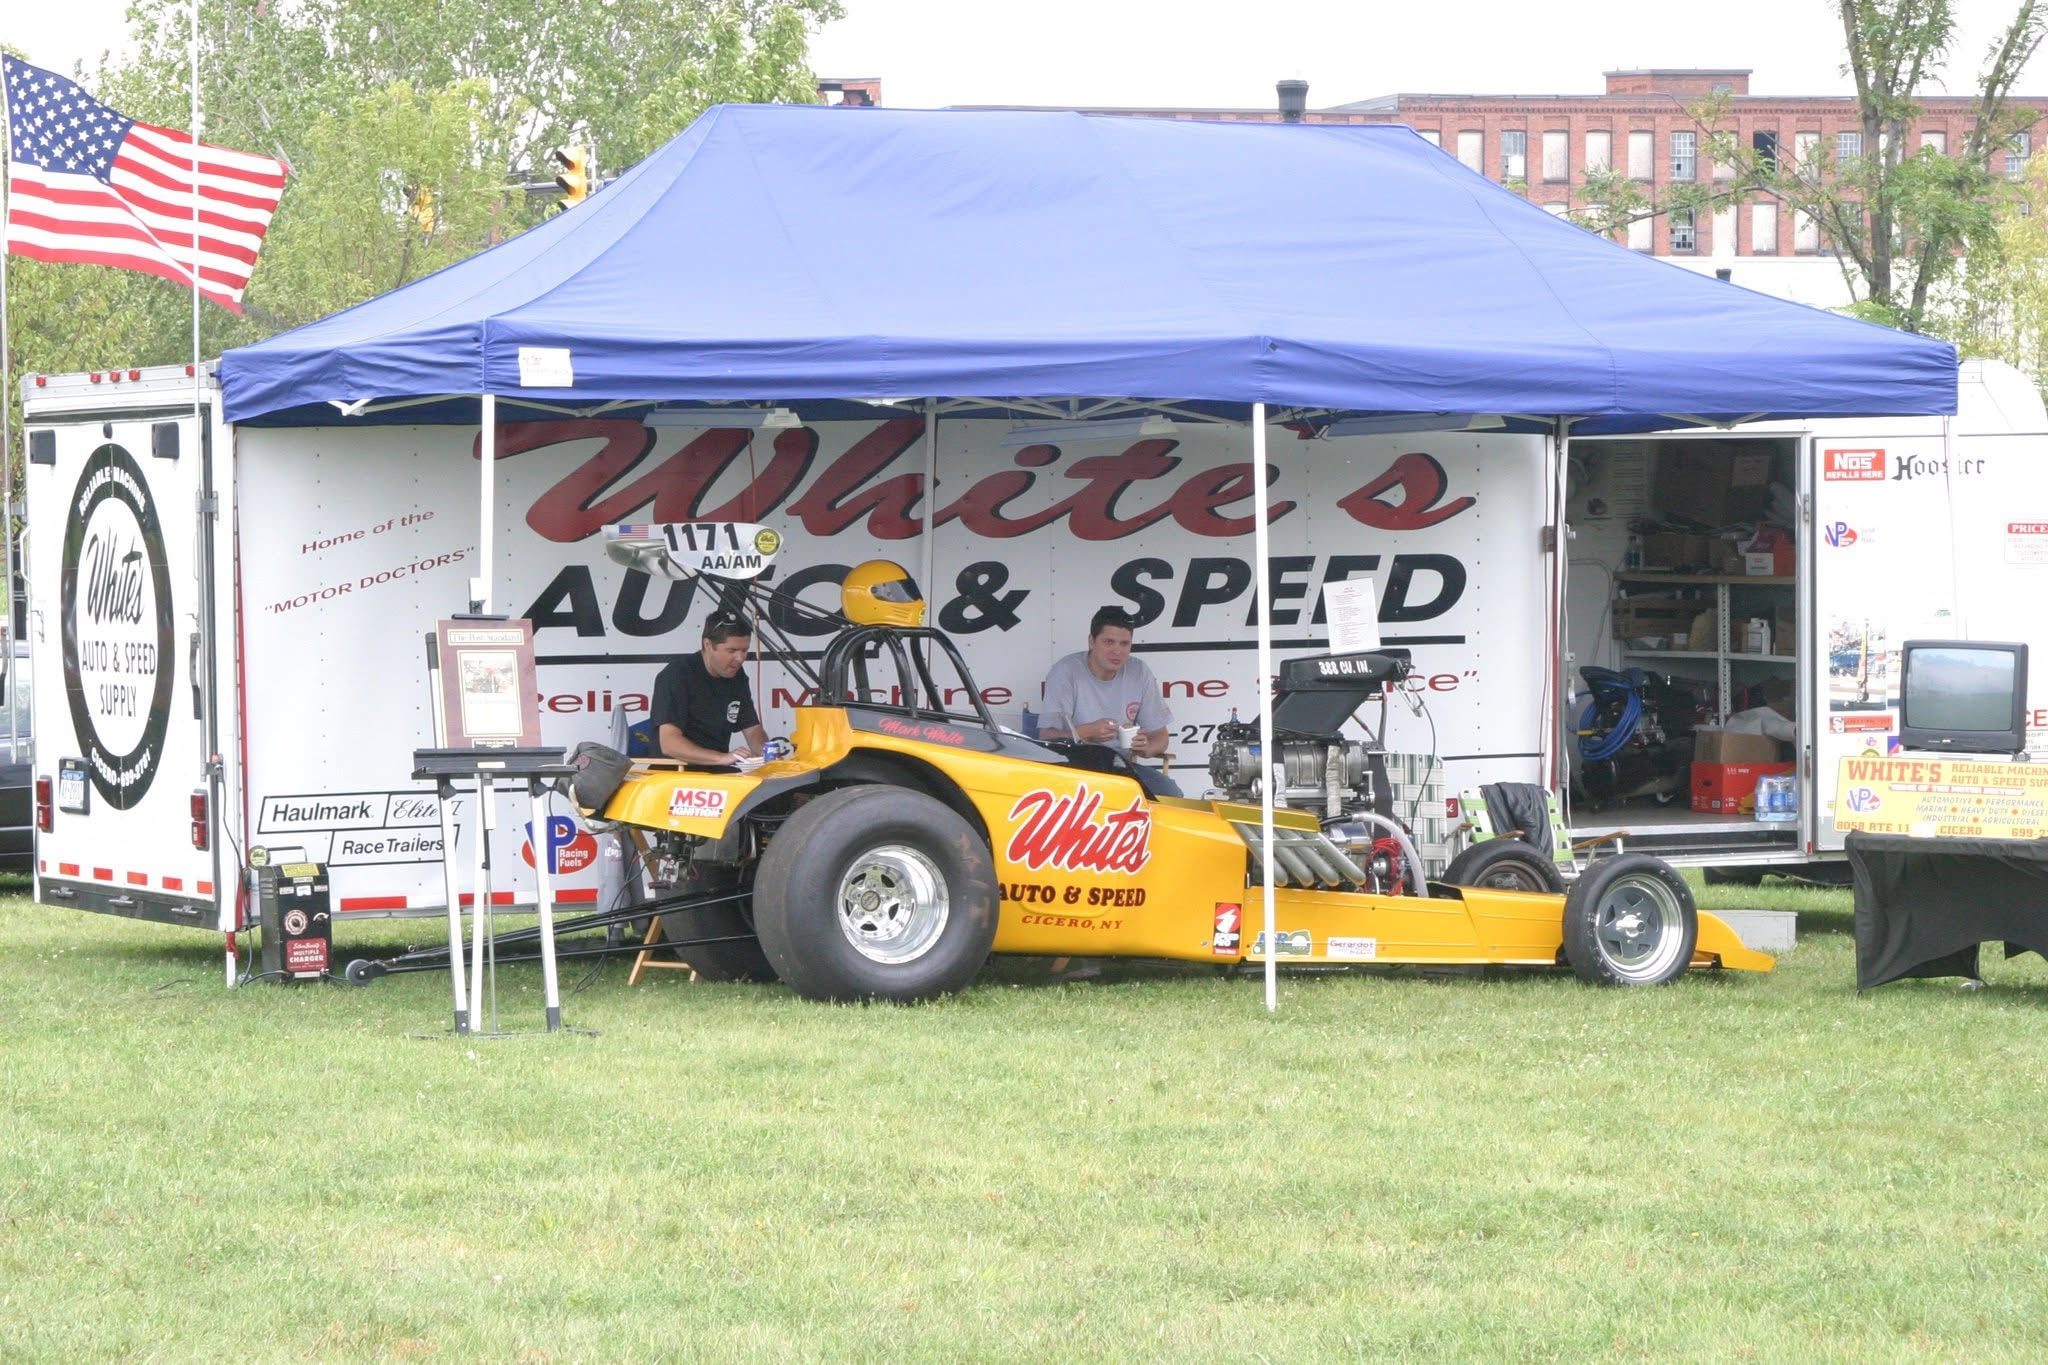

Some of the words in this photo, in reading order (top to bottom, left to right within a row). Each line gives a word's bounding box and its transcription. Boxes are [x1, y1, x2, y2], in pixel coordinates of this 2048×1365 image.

[1834, 452, 1876, 470] NOS
[1826, 470, 1859, 480] REFILLS
[1862, 469, 1884, 479] HERE
[302, 531, 365, 554] Home
[373, 519, 395, 534] of
[401, 511, 435, 526] the
[663, 523, 739, 551] 1171
[702, 555, 761, 569] AA/AM
[939, 561, 1030, 634] &
[82, 640, 108, 672] AUTO
[113, 642, 121, 672] &
[126, 643, 155, 675] SPEED
[1319, 661, 1339, 675] 388
[1340, 660, 1356, 674] CU.
[1357, 660, 1373, 673] IN.
[100, 684, 137, 717] SUPPLY
[772, 685, 1012, 709] Mchne
[1848, 760, 1942, 783] WHITE'S
[1951, 763, 2004, 775] RELIABLE
[1951, 775, 1979, 786] AUTO
[1993, 777, 2027, 787] SPEED
[674, 790, 723, 808] MSD
[1921, 796, 1973, 805] AUTOMOTIVE
[1985, 798, 2044, 808] PERFORMANCE
[272, 801, 371, 823] Haulmark
[393, 799, 439, 819] Elite
[672, 807, 719, 817] IGNITION
[1916, 805, 1947, 813] MARINE
[1960, 806, 1986, 815] HEAVY
[1989, 807, 2009, 816] DUTY
[1836, 820, 1865, 831] 8058
[1869, 822, 1892, 832] RTE
[1940, 825, 1983, 836] CICERO
[2011, 828, 2048, 838] 699-2
[1923, 814, 1969, 823] INDUSTRIAL
[1982, 816, 2040, 826] AGRICULTURAL
[342, 841, 384, 856] Race
[387, 837, 444, 852] Trailers
[560, 849, 588, 858] Racing
[560, 859, 582, 867] Fuels
[1000, 882, 1056, 904] AUTO
[1063, 886, 1081, 904] &
[1087, 886, 1146, 907] SPEED
[1100, 919, 1123, 930] NY
[289, 955, 324, 963] CHARGER
